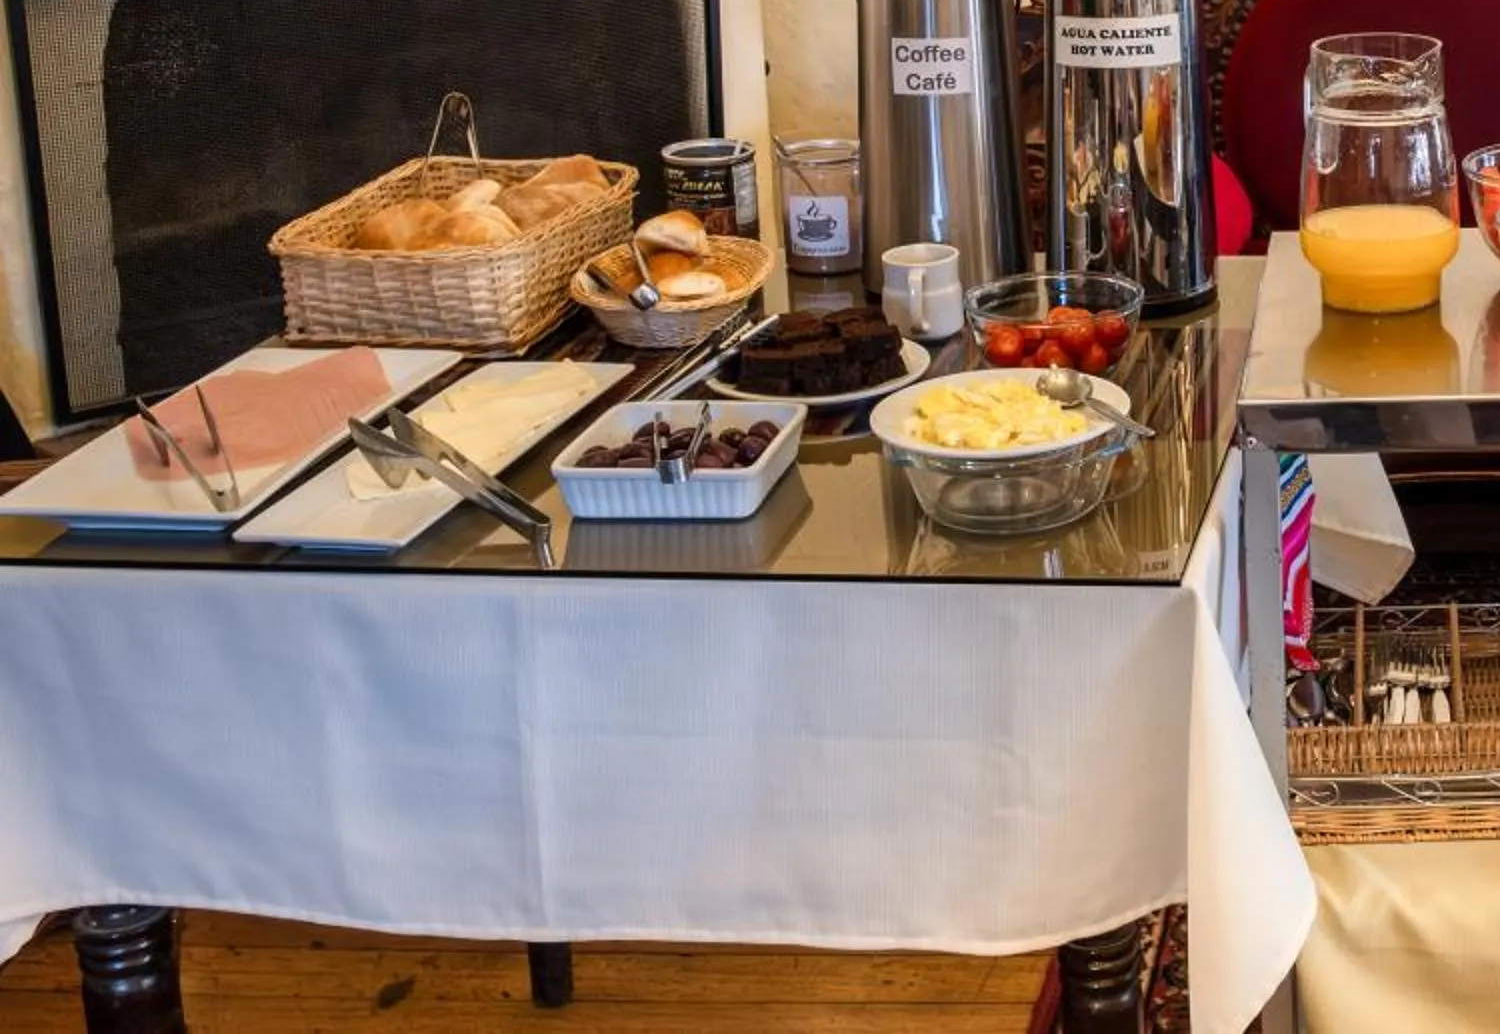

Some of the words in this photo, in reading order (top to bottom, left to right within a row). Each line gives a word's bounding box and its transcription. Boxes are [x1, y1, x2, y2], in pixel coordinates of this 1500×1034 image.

[1061, 27, 1096, 39] AGUA
[1099, 26, 1172, 39] CALIENTE
[895, 44, 966, 63] Coffee
[1071, 45, 1097, 56] HOT
[1100, 44, 1155, 56] WATER
[906, 72, 957, 91] Café
